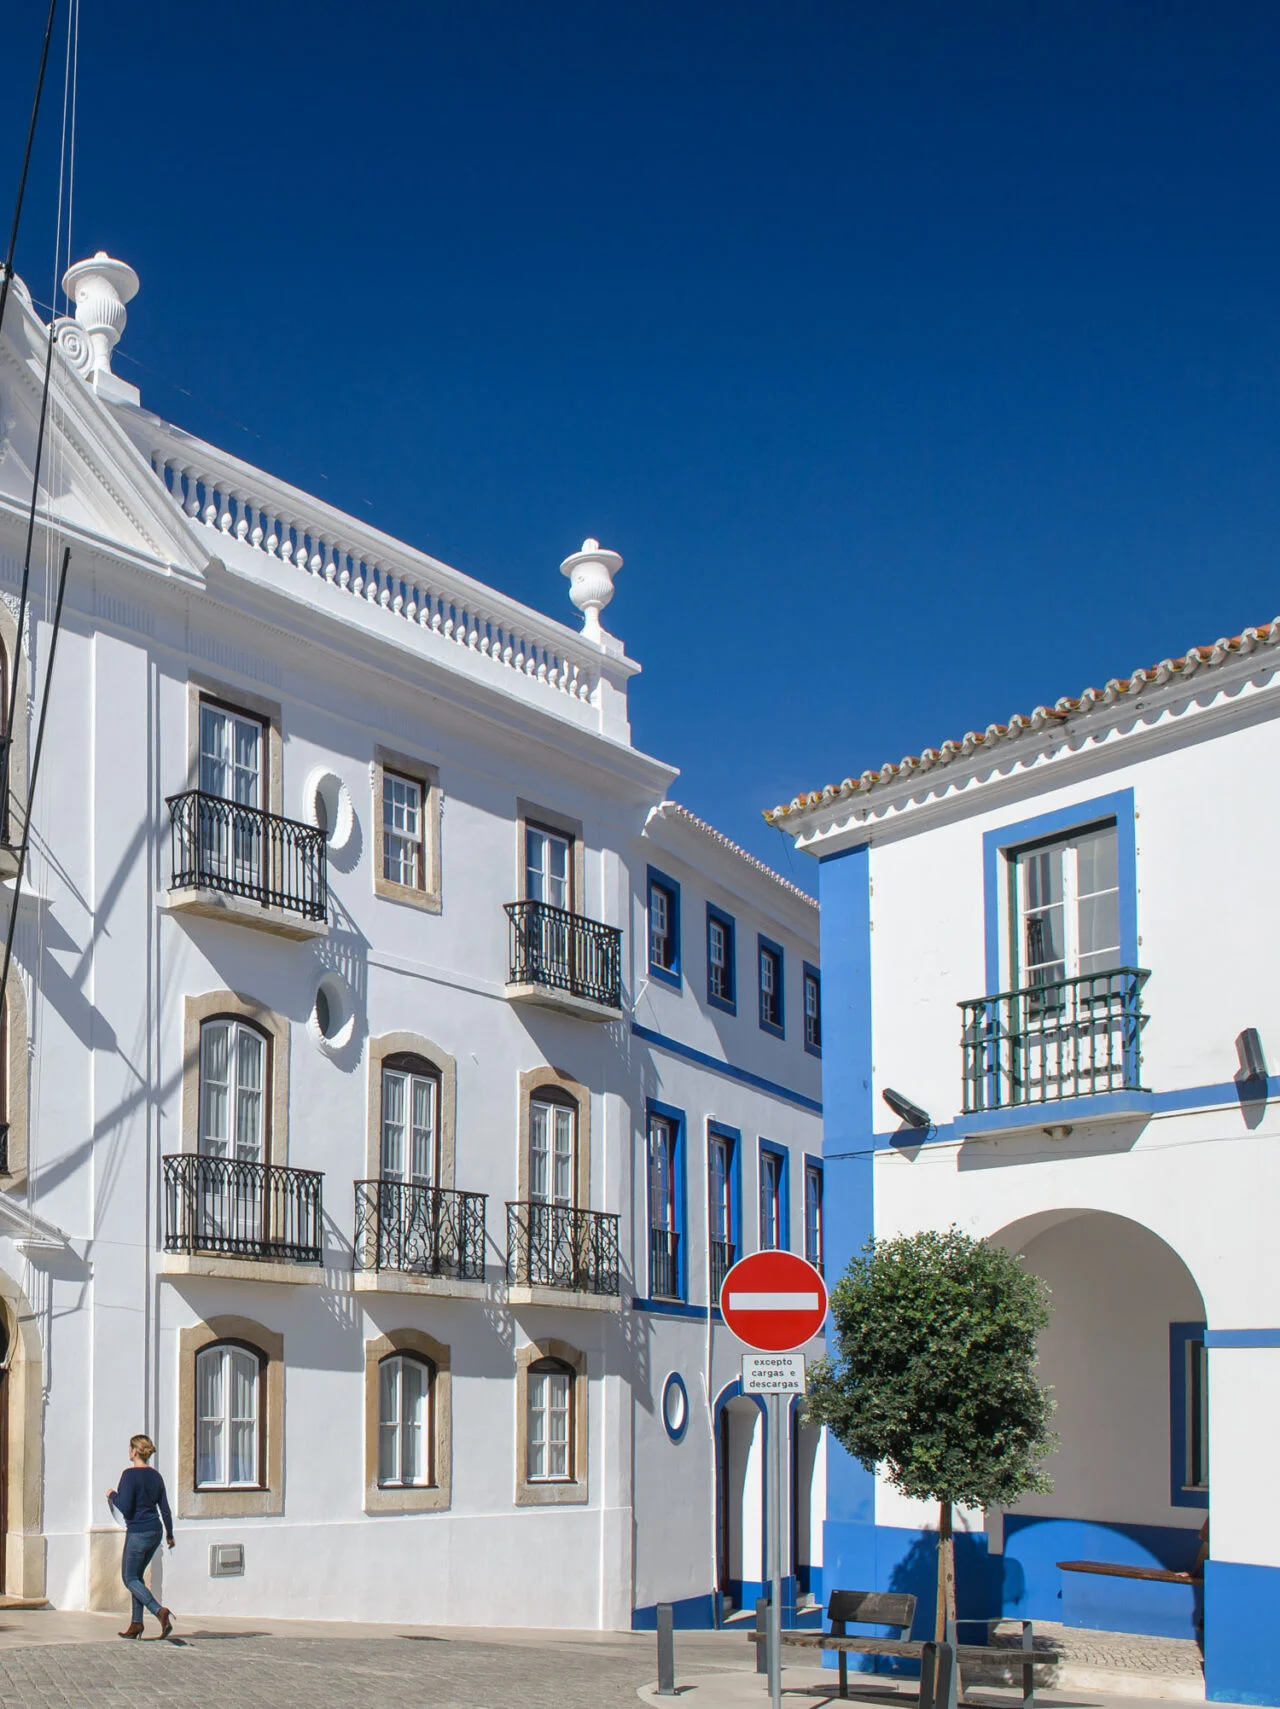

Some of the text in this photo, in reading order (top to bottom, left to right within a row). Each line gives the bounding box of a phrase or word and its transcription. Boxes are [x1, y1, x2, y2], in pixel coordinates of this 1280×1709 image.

[754, 1358, 792, 1367] excepto
[751, 1370, 784, 1378] cargas
[749, 1380, 799, 1389] descargas
